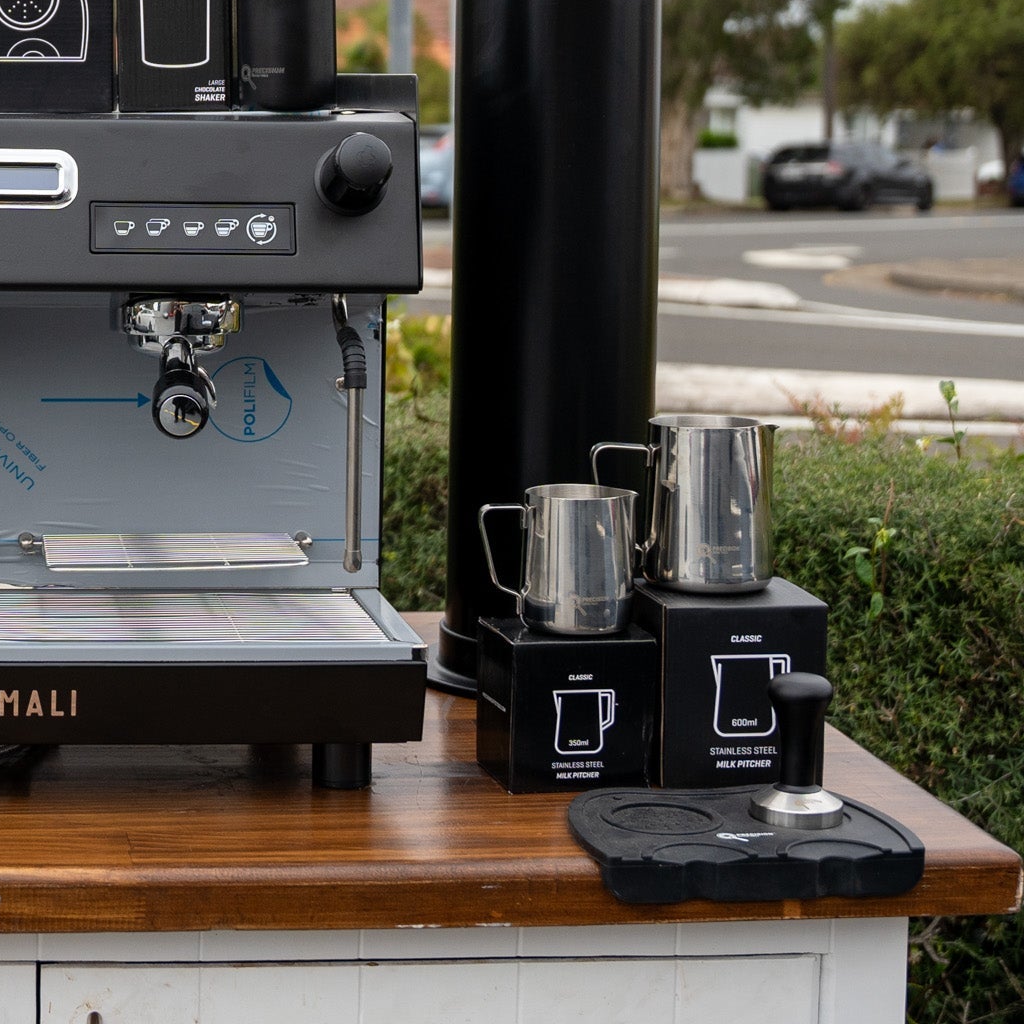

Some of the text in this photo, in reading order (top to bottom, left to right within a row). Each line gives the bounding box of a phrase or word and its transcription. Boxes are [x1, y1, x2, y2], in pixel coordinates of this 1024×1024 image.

[194, 93, 226, 102] SHAKER
[243, 362, 256, 436] POLIFILM
[16, 439, 47, 472] FIBER
[730, 634, 763, 643] CLASSIC
[568, 673, 594, 681] CLASSIC
[731, 718, 758, 727] 600ml
[568, 738, 589, 747] 350ml
[709, 745, 778, 756] STAINLESS STEEL
[551, 760, 605, 770] STAINLESS STEEL
[715, 759, 772, 769] MILK PITCHER
[555, 771, 600, 780] MILK PITCHER
